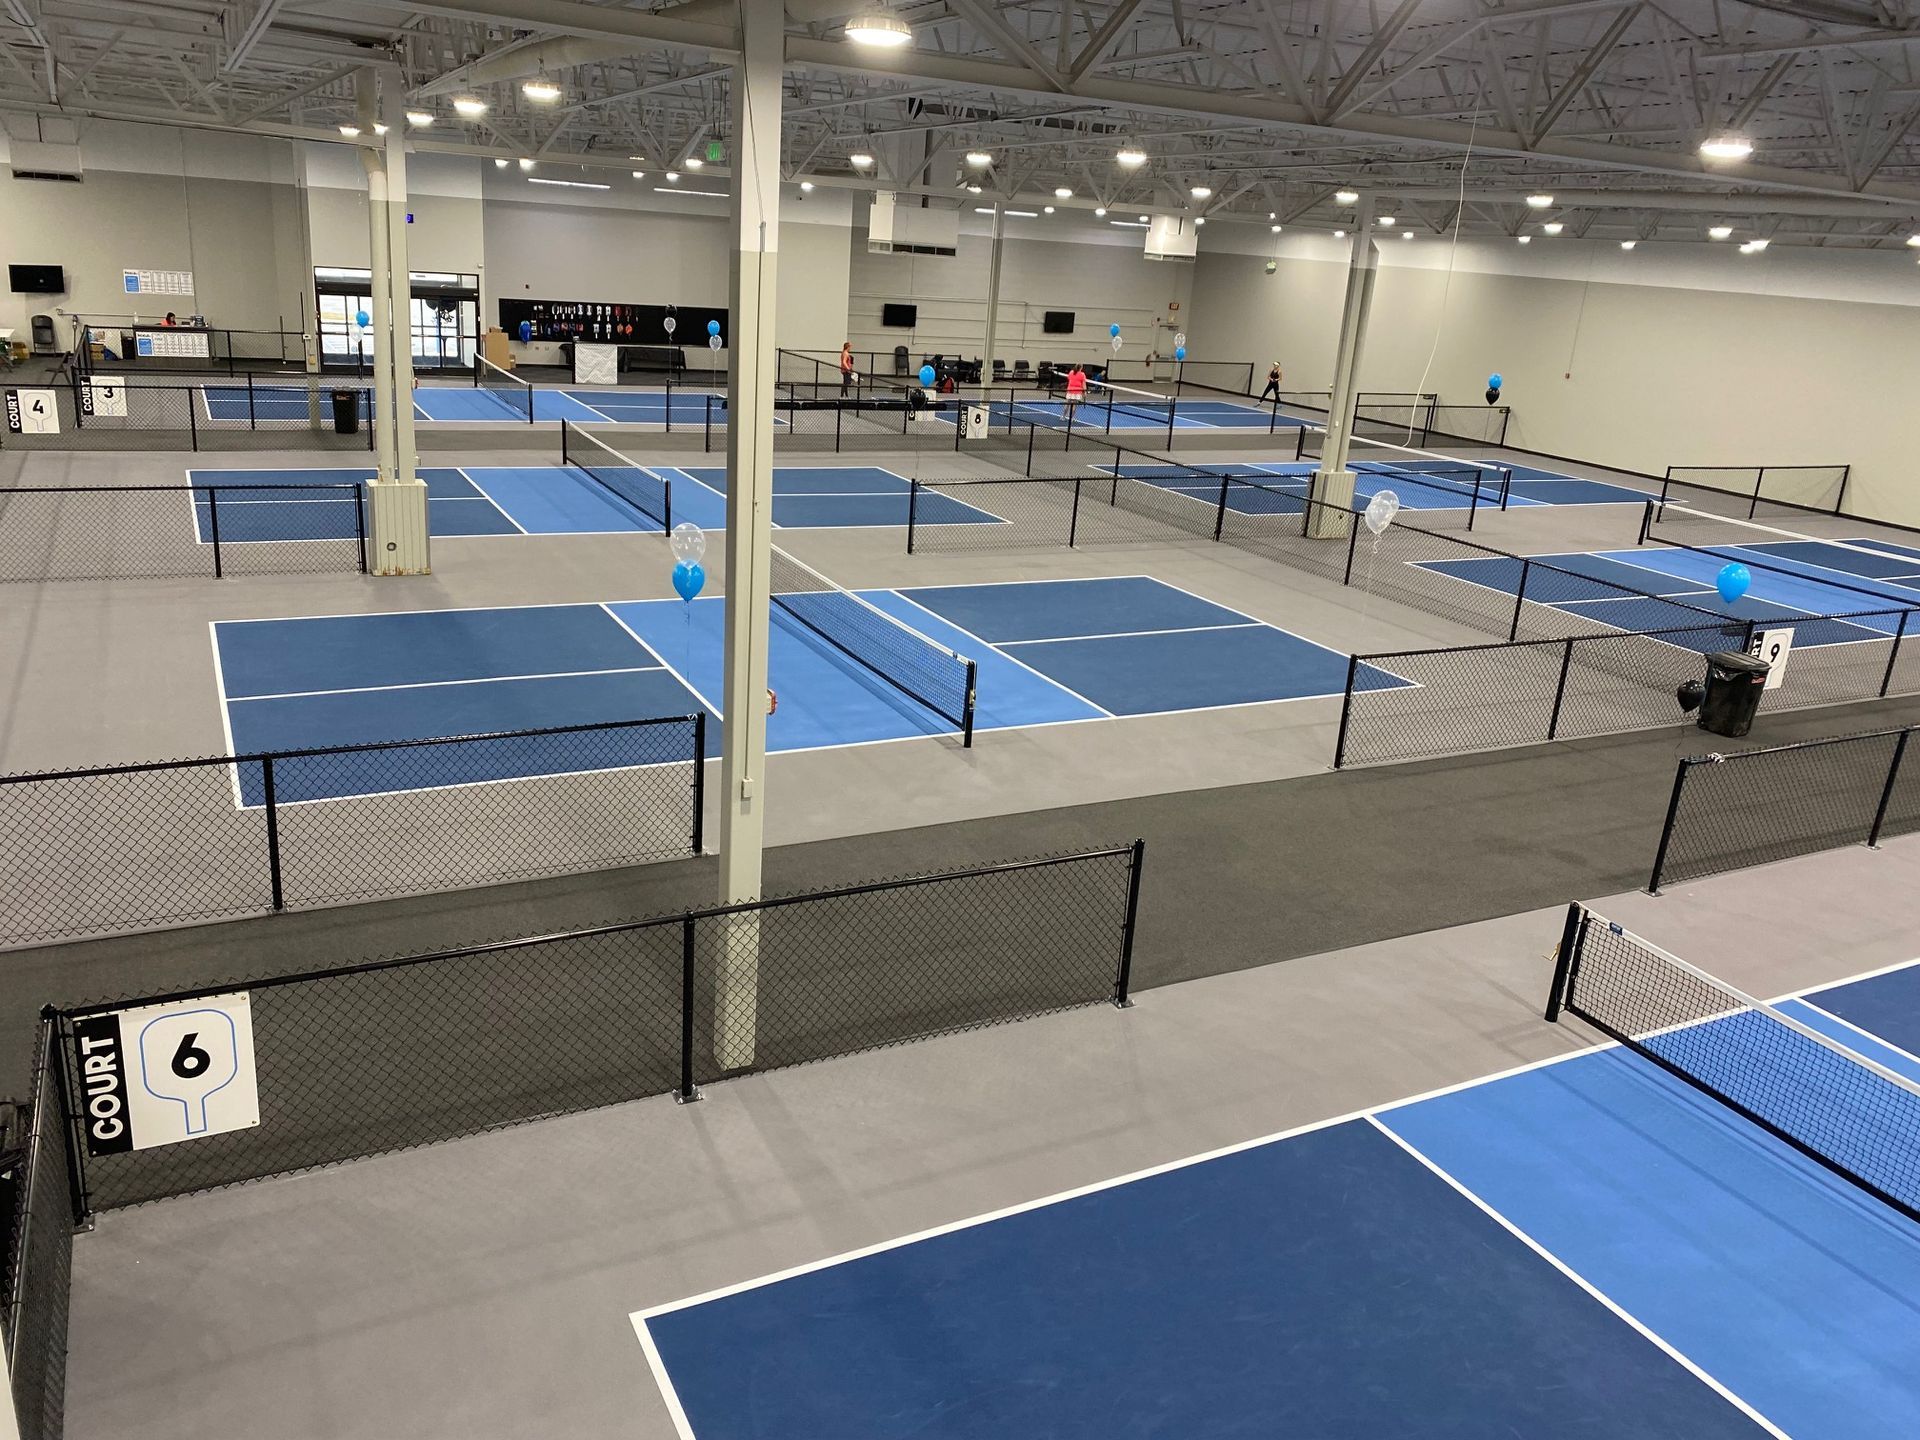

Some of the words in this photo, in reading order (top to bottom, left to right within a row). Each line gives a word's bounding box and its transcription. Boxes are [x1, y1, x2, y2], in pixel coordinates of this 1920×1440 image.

[81, 380, 92, 411] COURT
[103, 386, 114, 399] 3
[7, 394, 20, 428] COURT
[32, 400, 44, 414] 4
[975, 413, 981, 424] 8
[960, 410, 968, 435] COURT
[1771, 643, 1780, 663] 9
[171, 1032, 211, 1079] 6
[81, 1036, 124, 1140] COURT
